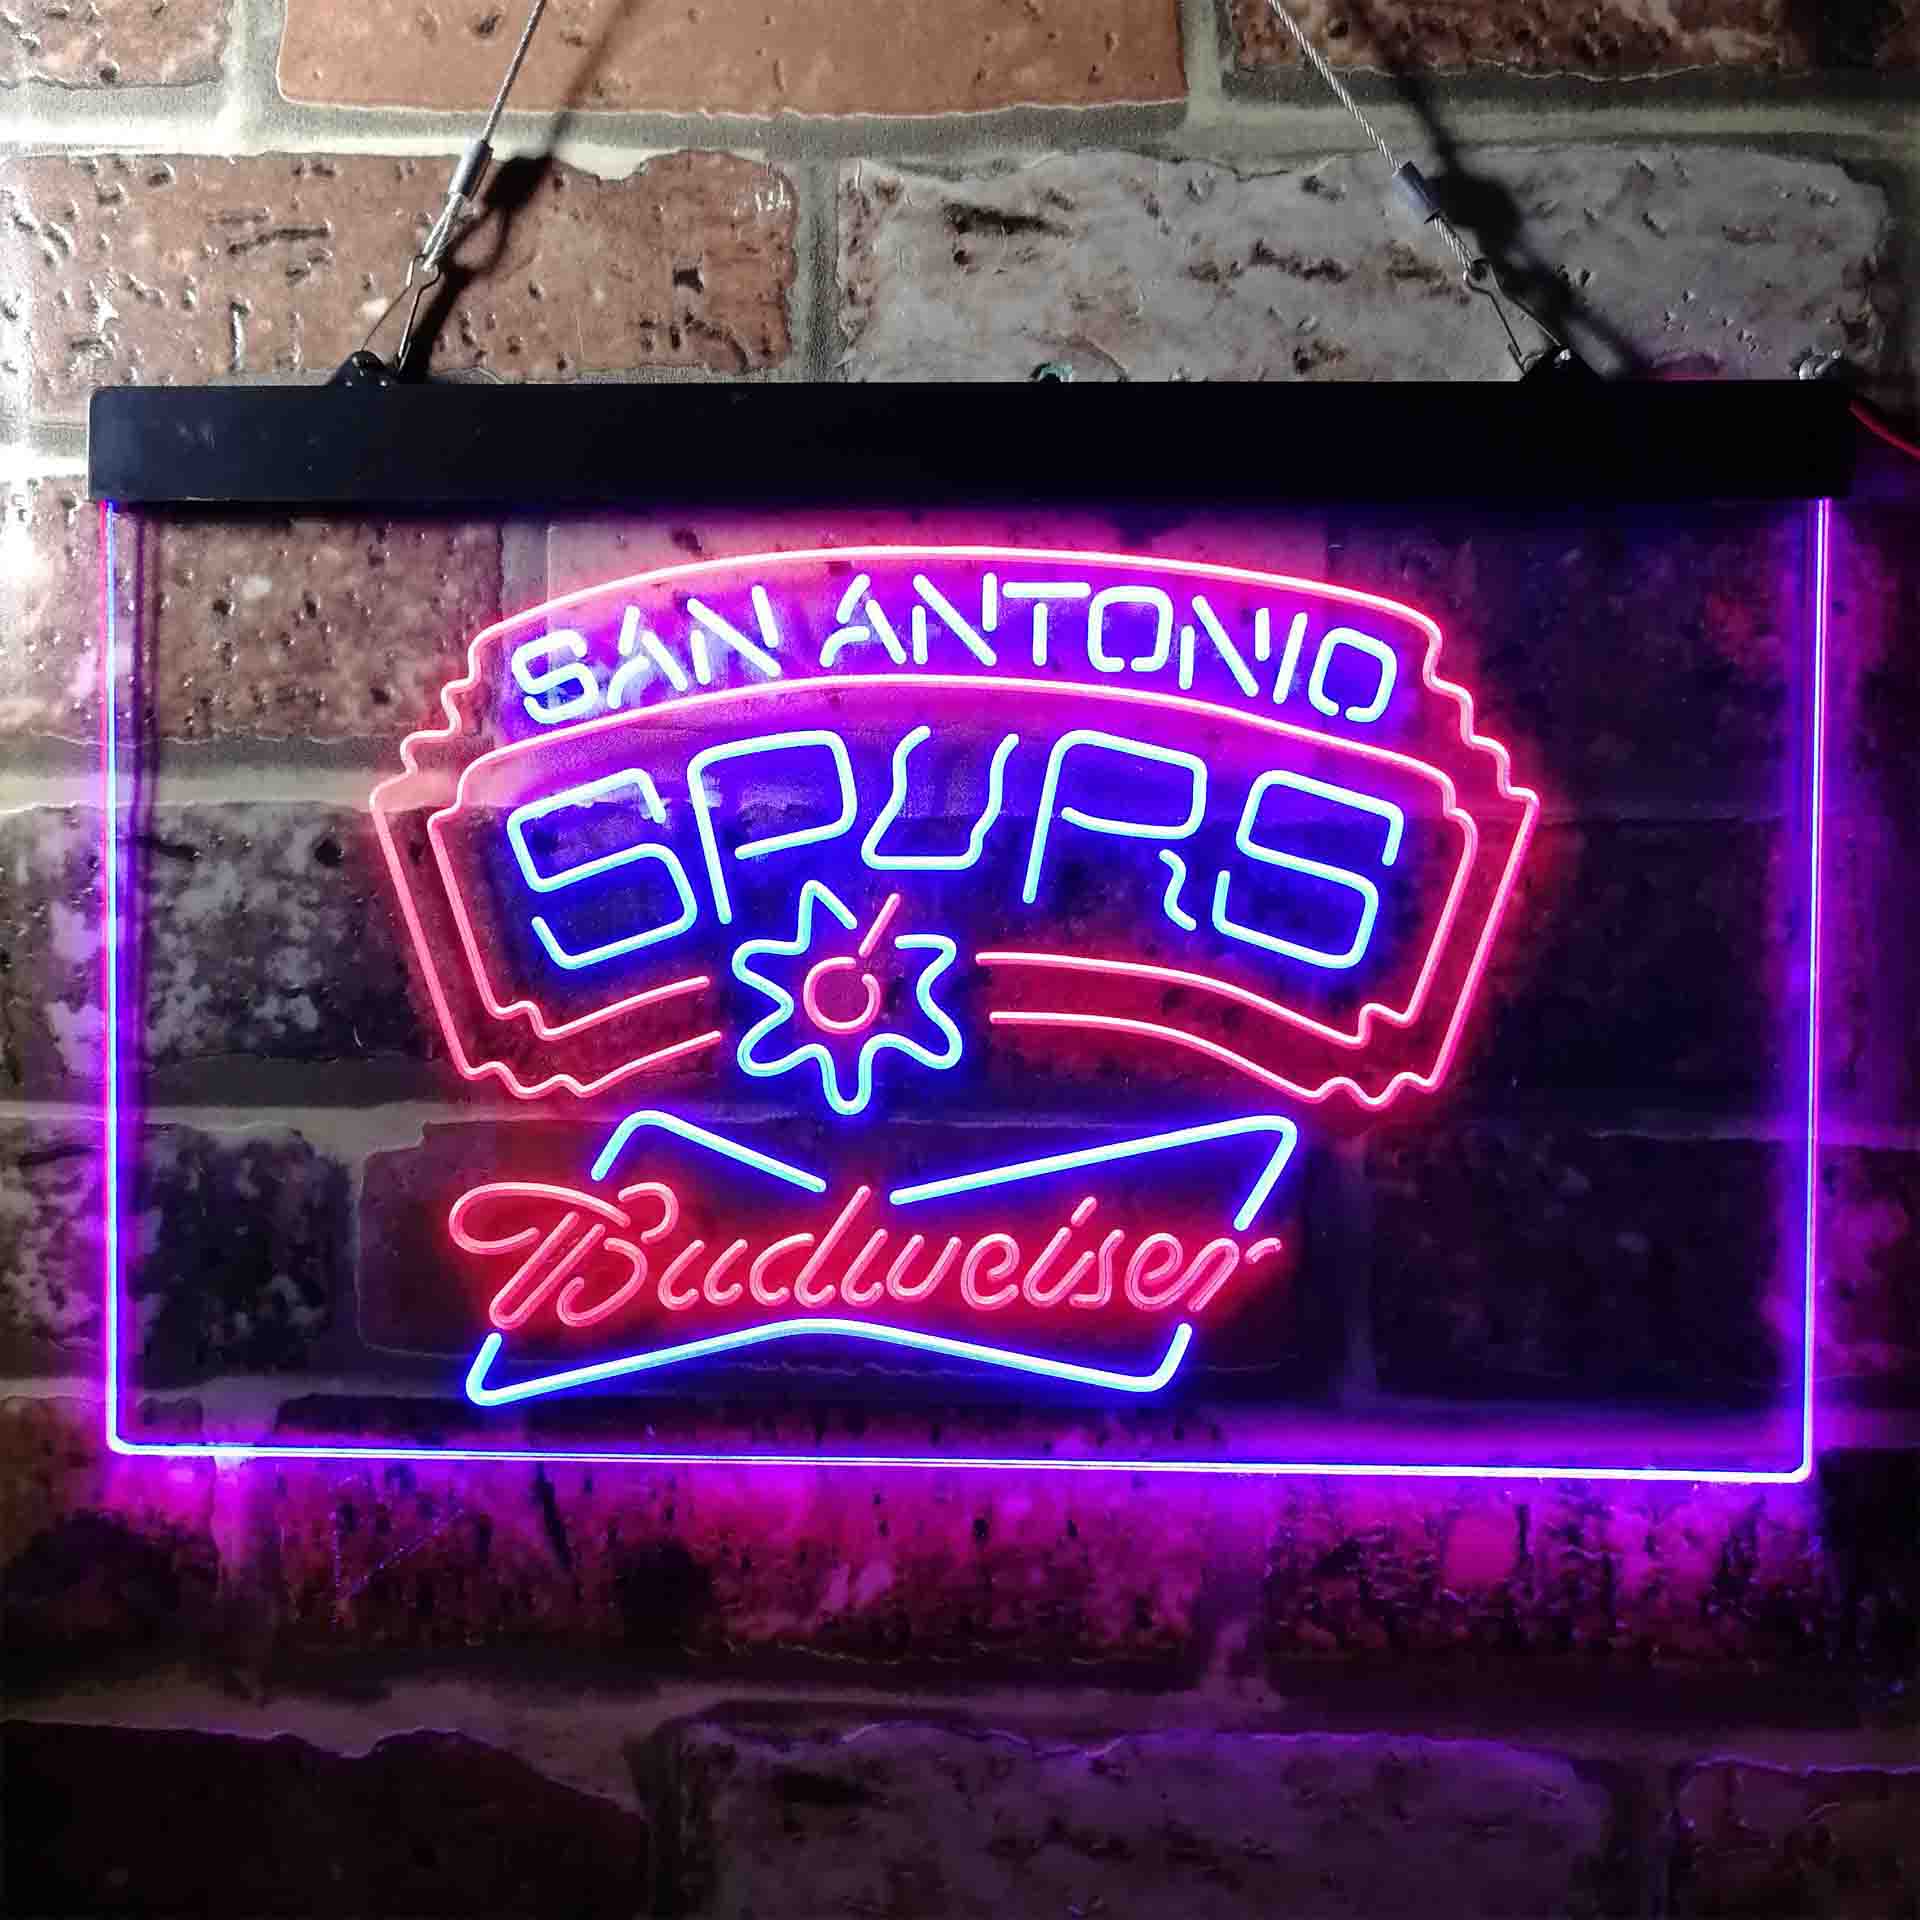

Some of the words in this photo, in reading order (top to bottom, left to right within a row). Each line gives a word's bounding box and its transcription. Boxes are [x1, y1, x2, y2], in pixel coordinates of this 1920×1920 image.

[511, 585, 782, 724] SAN
[819, 572, 1398, 723] ANTONIO
[506, 726, 1404, 970] SPURS
[448, 1181, 1282, 1329] Budweiser
